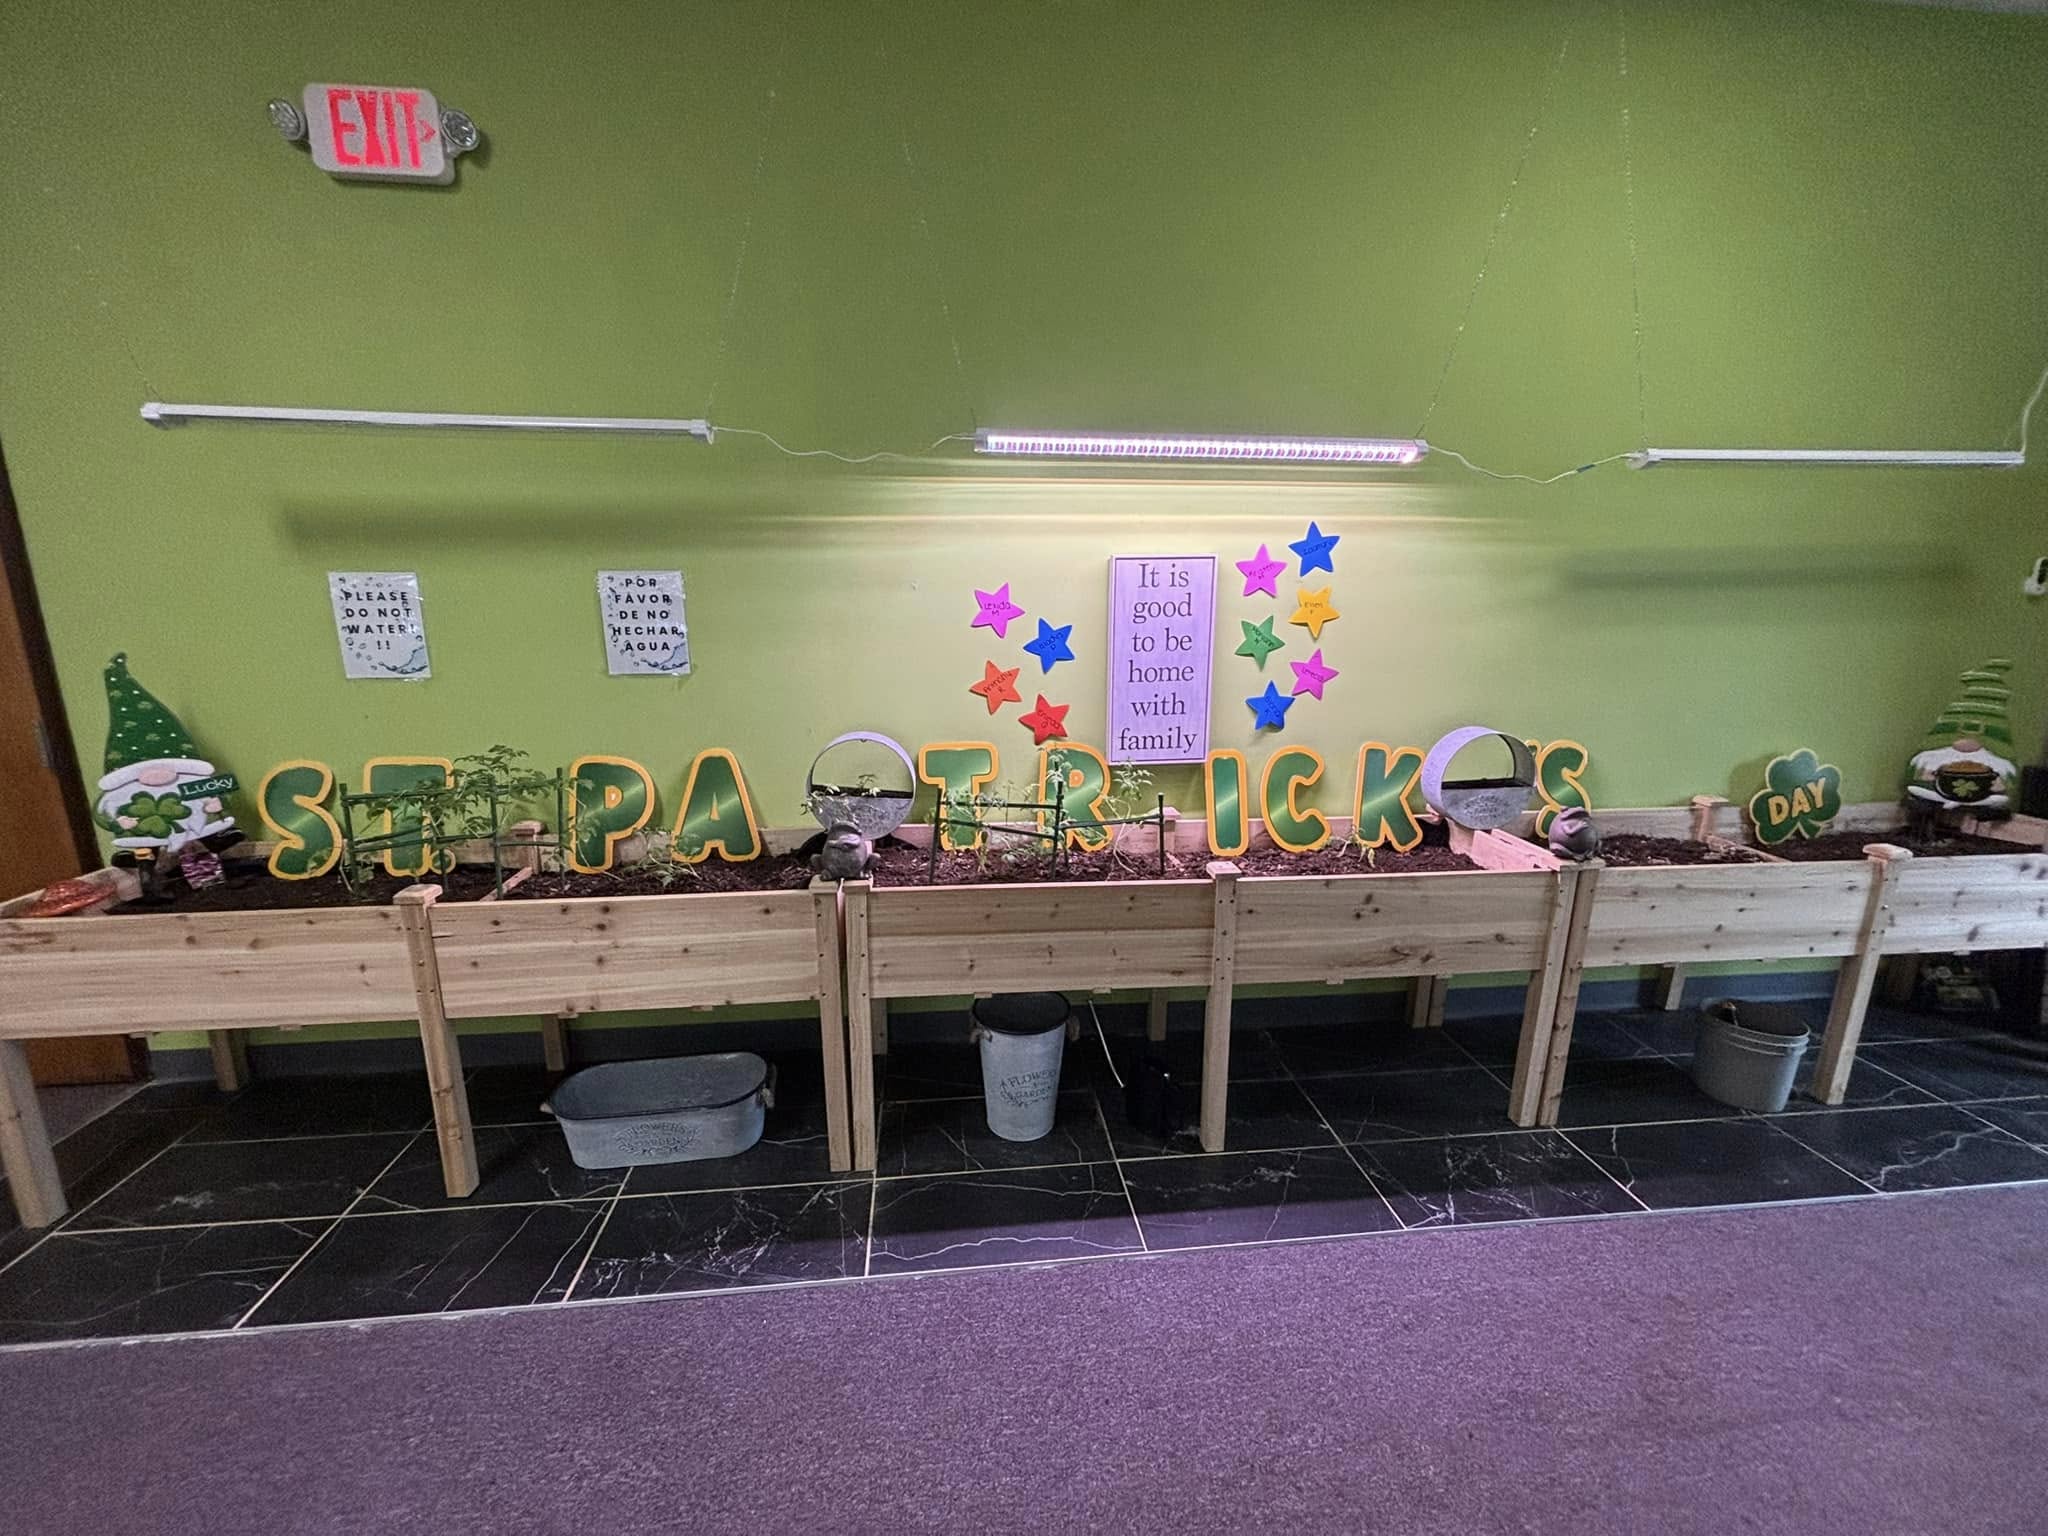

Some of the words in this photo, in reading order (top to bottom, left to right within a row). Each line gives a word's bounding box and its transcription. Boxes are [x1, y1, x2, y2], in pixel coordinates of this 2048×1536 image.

[326, 88, 422, 168] EXIT
[625, 578, 657, 588] POR
[1138, 563, 1160, 588] It
[1168, 563, 1190, 588] is
[343, 591, 409, 601] PLEASE
[615, 594, 671, 604] FAVOR
[345, 608, 369, 618] DO
[377, 608, 412, 618] NOT
[619, 610, 639, 620] DE
[647, 610, 670, 620] NO
[1132, 592, 1193, 624] good
[346, 624, 416, 634] WATER!
[611, 626, 679, 636] HECHAR
[624, 641, 671, 651] AGUA
[1131, 632, 1155, 652] to
[1164, 627, 1193, 652] be
[1127, 659, 1195, 684] home
[1131, 692, 1187, 716] with
[1117, 726, 1198, 754] family
[183, 777, 233, 795] Lucky
[1767, 777, 1826, 826] DAY
